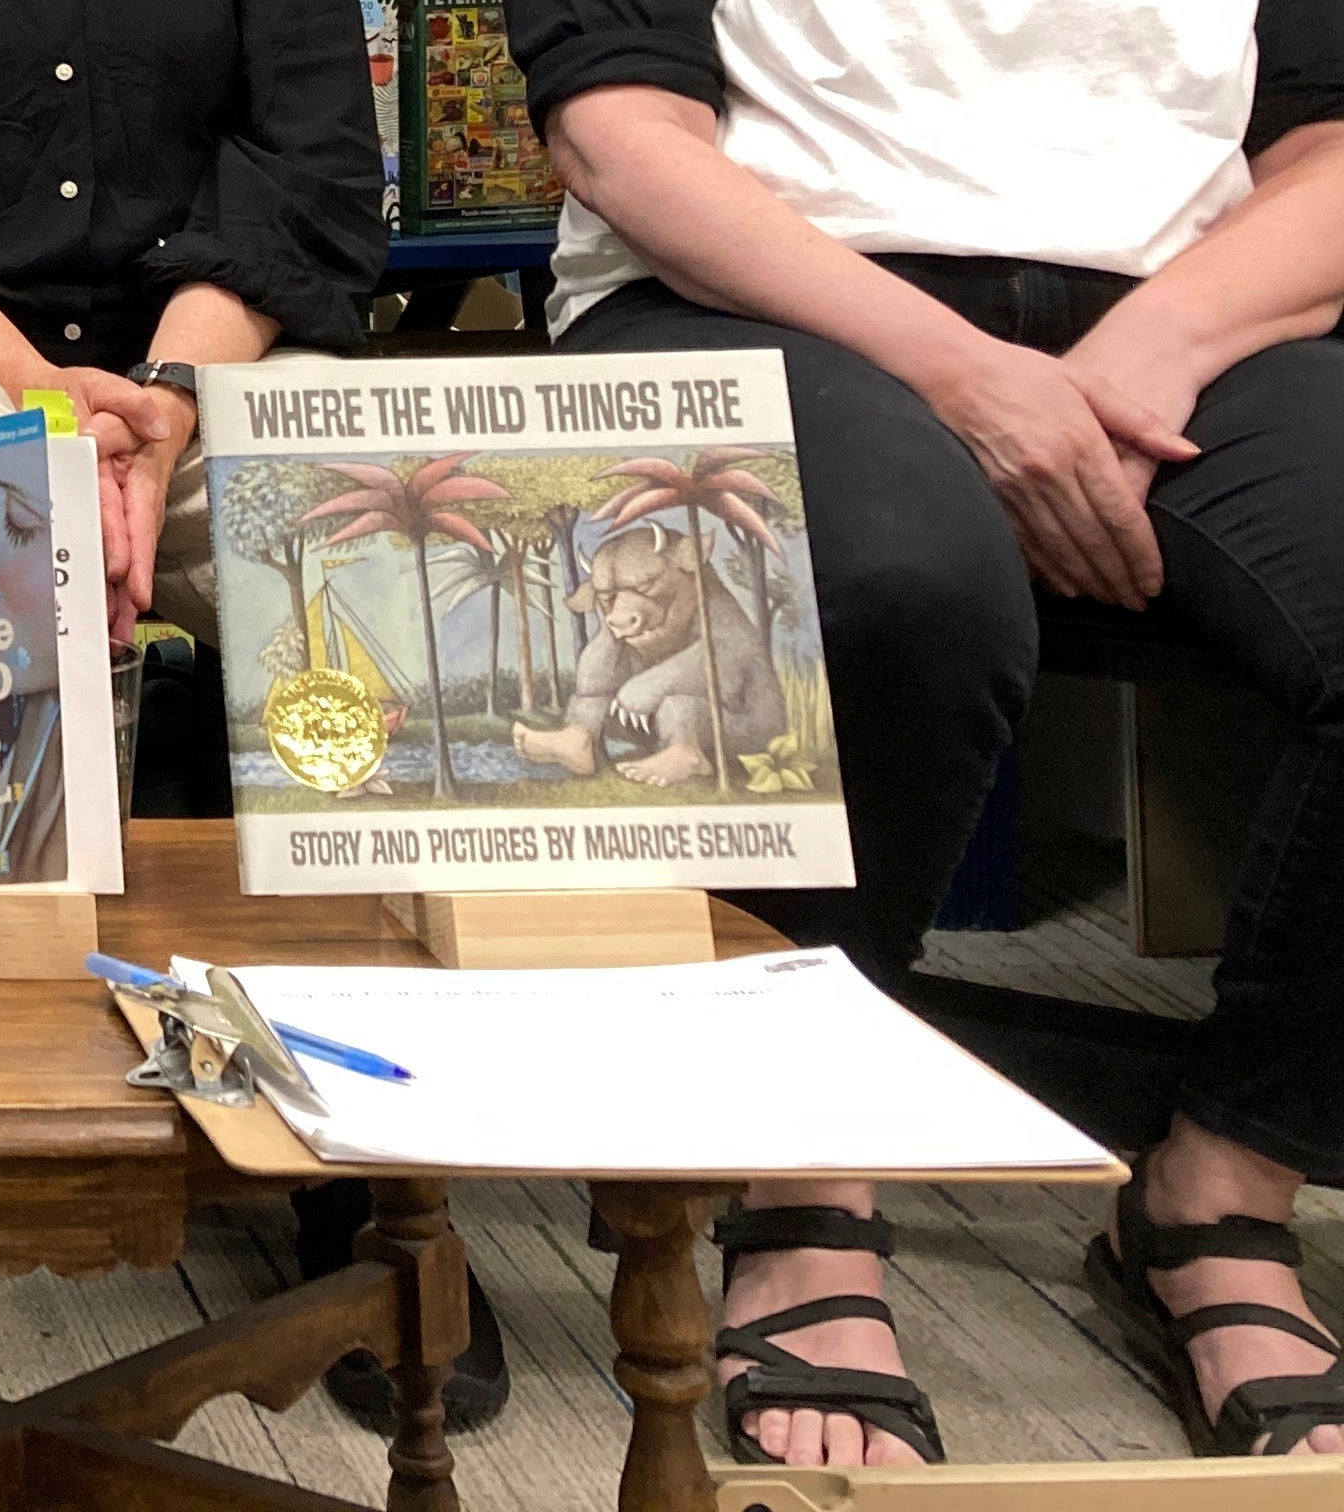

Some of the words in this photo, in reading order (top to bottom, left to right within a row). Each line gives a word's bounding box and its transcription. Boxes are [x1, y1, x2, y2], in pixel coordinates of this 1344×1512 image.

[245, 388, 365, 440] WHERE
[371, 387, 434, 435] THE
[444, 384, 526, 435] WILD
[535, 379, 662, 432] THINGS
[672, 378, 743, 429] ARE
[291, 829, 362, 866] STORY
[371, 828, 420, 864] AND
[426, 824, 538, 864] PICTURES
[545, 824, 575, 861] BY
[584, 823, 692, 861] MAURICE
[699, 821, 797, 859] SENDAK
